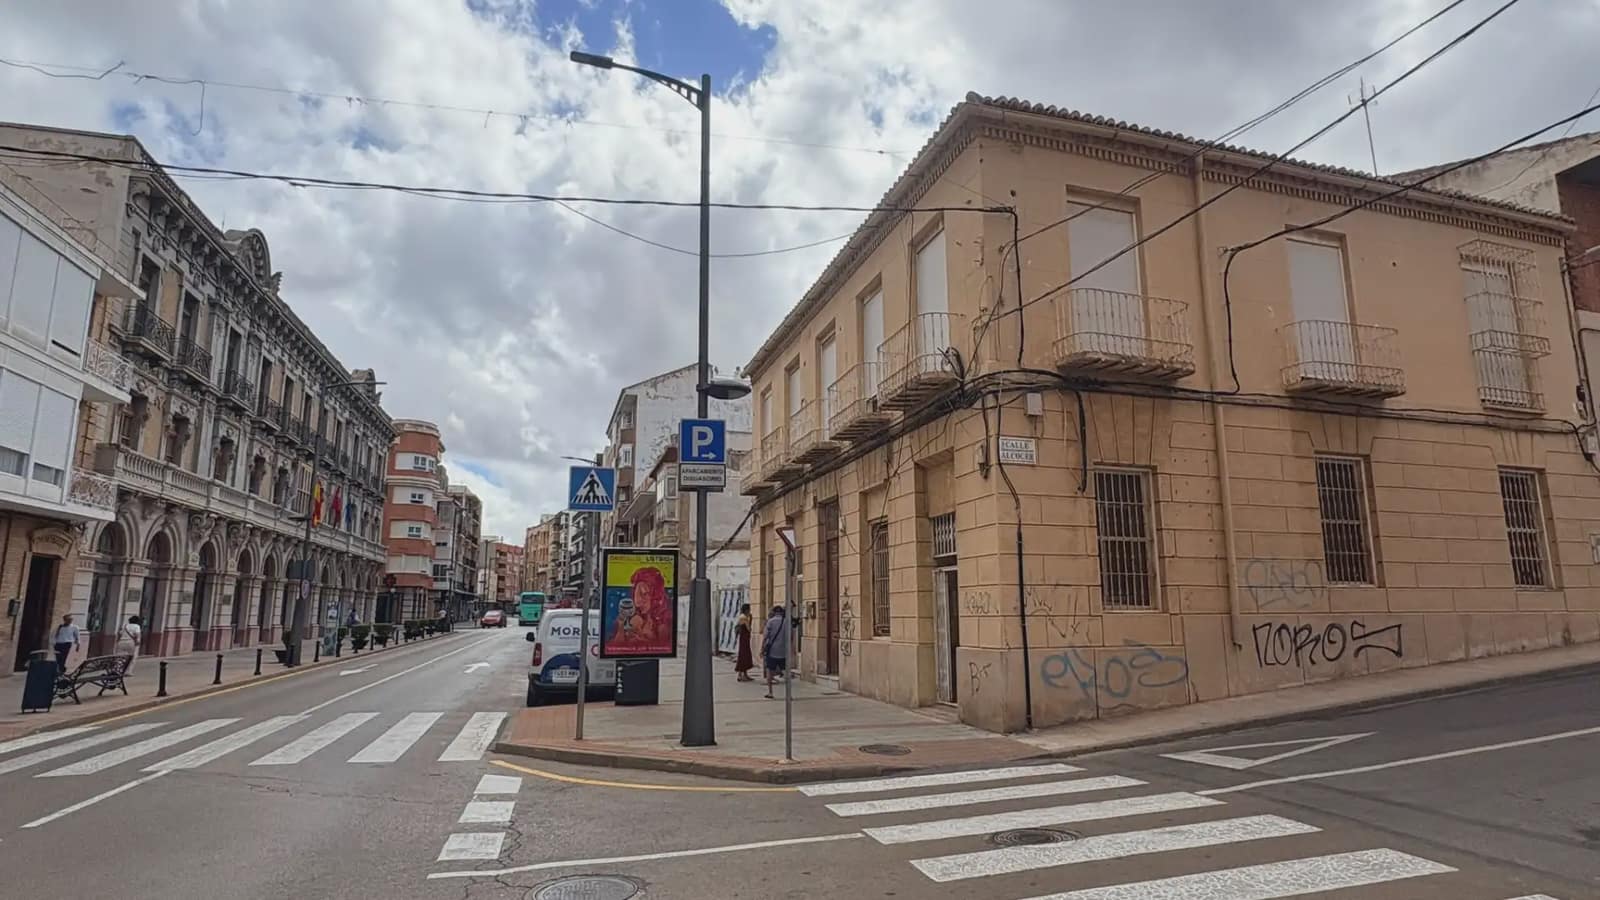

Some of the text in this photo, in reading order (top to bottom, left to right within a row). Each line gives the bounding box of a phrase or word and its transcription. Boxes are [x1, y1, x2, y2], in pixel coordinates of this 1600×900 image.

[691, 425, 714, 457] P
[1005, 441, 1029, 450] CALLE
[551, 626, 600, 637] MORL
